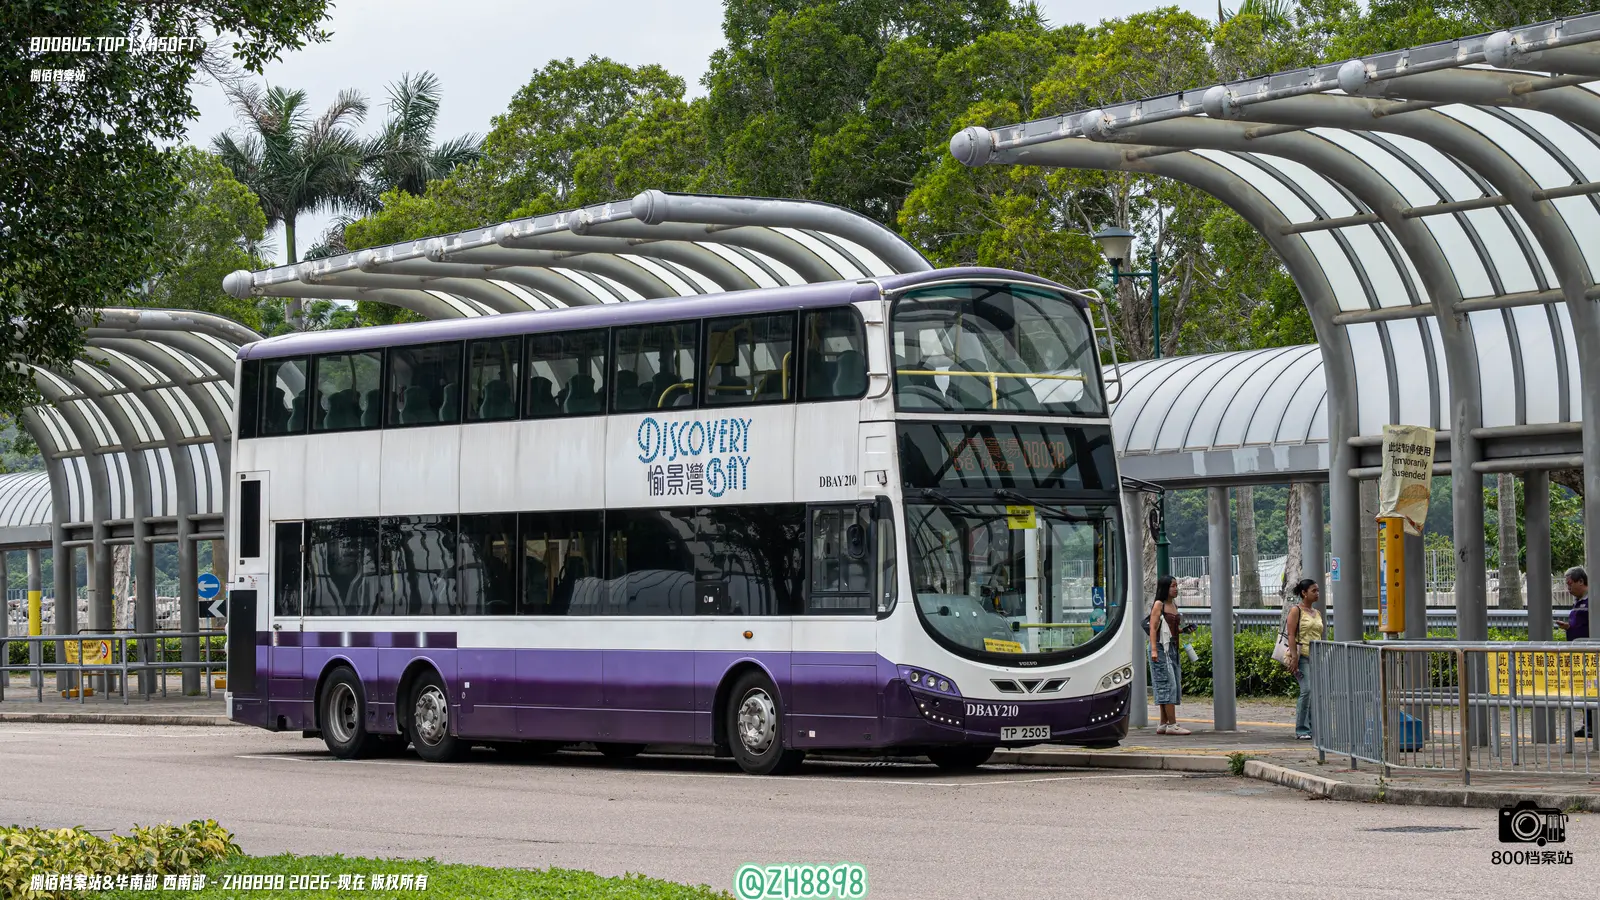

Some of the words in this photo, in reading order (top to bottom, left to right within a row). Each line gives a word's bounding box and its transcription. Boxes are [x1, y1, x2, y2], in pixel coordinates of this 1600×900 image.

[637, 416, 752, 463] DISCOVERY
[1388, 441, 1431, 457] 此站暫停使用
[647, 462, 704, 497] 愉景灣
[706, 455, 751, 498] BAY
[818, 474, 857, 488] DBAY210
[1392, 468, 1426, 480] Susended
[1498, 654, 1600, 668] 此共運輸設施嚴禁吸煙
[1561, 669, 1581, 677] Tranport
[965, 703, 1019, 717] DBAY210
[1003, 728, 1018, 739] TP
[1021, 727, 1048, 739] 2505
